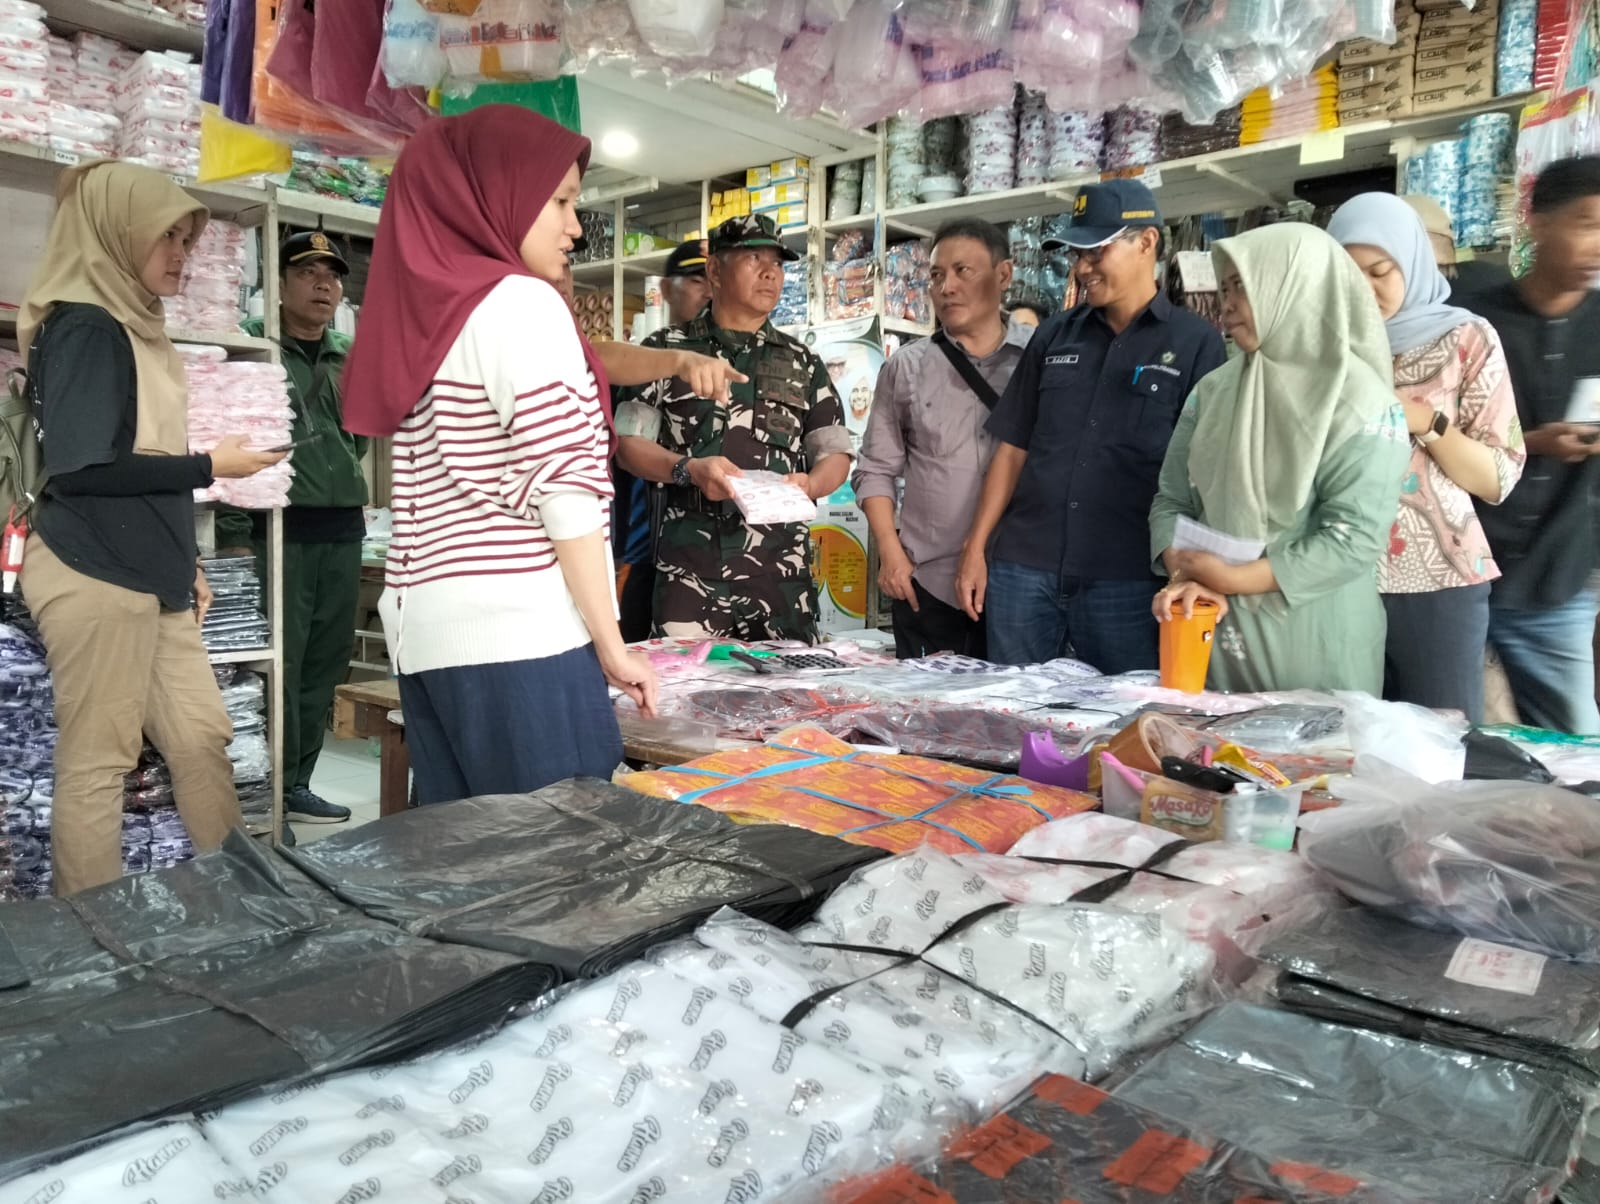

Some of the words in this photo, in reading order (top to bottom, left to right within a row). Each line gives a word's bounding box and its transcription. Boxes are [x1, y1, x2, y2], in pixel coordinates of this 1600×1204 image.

[529, 1062, 573, 1113] Hanna
[122, 1136, 191, 1187] Hanna
[249, 1116, 309, 1157] Hanna
[527, 1116, 574, 1166] Hanna
[617, 1115, 662, 1173] Hanna
